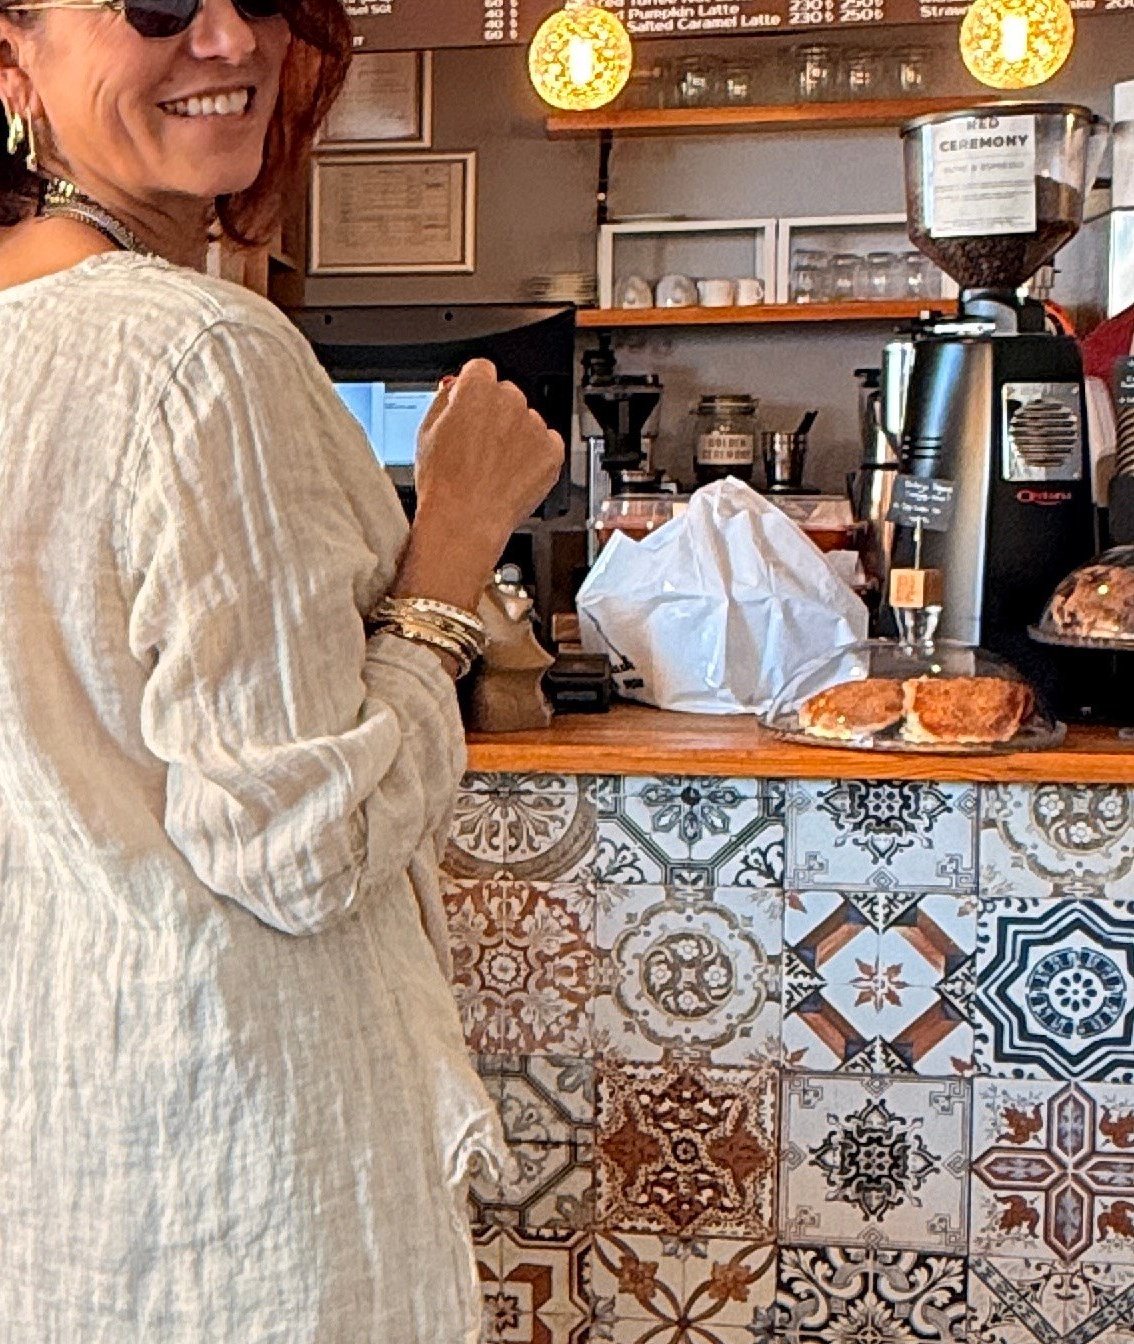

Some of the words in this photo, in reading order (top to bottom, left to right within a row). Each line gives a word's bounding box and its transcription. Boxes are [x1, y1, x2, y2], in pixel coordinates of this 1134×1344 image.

[629, 5, 695, 20] Pumpkin
[698, 3, 740, 17] Latte
[627, 19, 674, 33] Salted
[677, 16, 737, 31] Caramel
[740, 13, 781, 28] Latte
[939, 134, 1029, 152] CEREMONY
